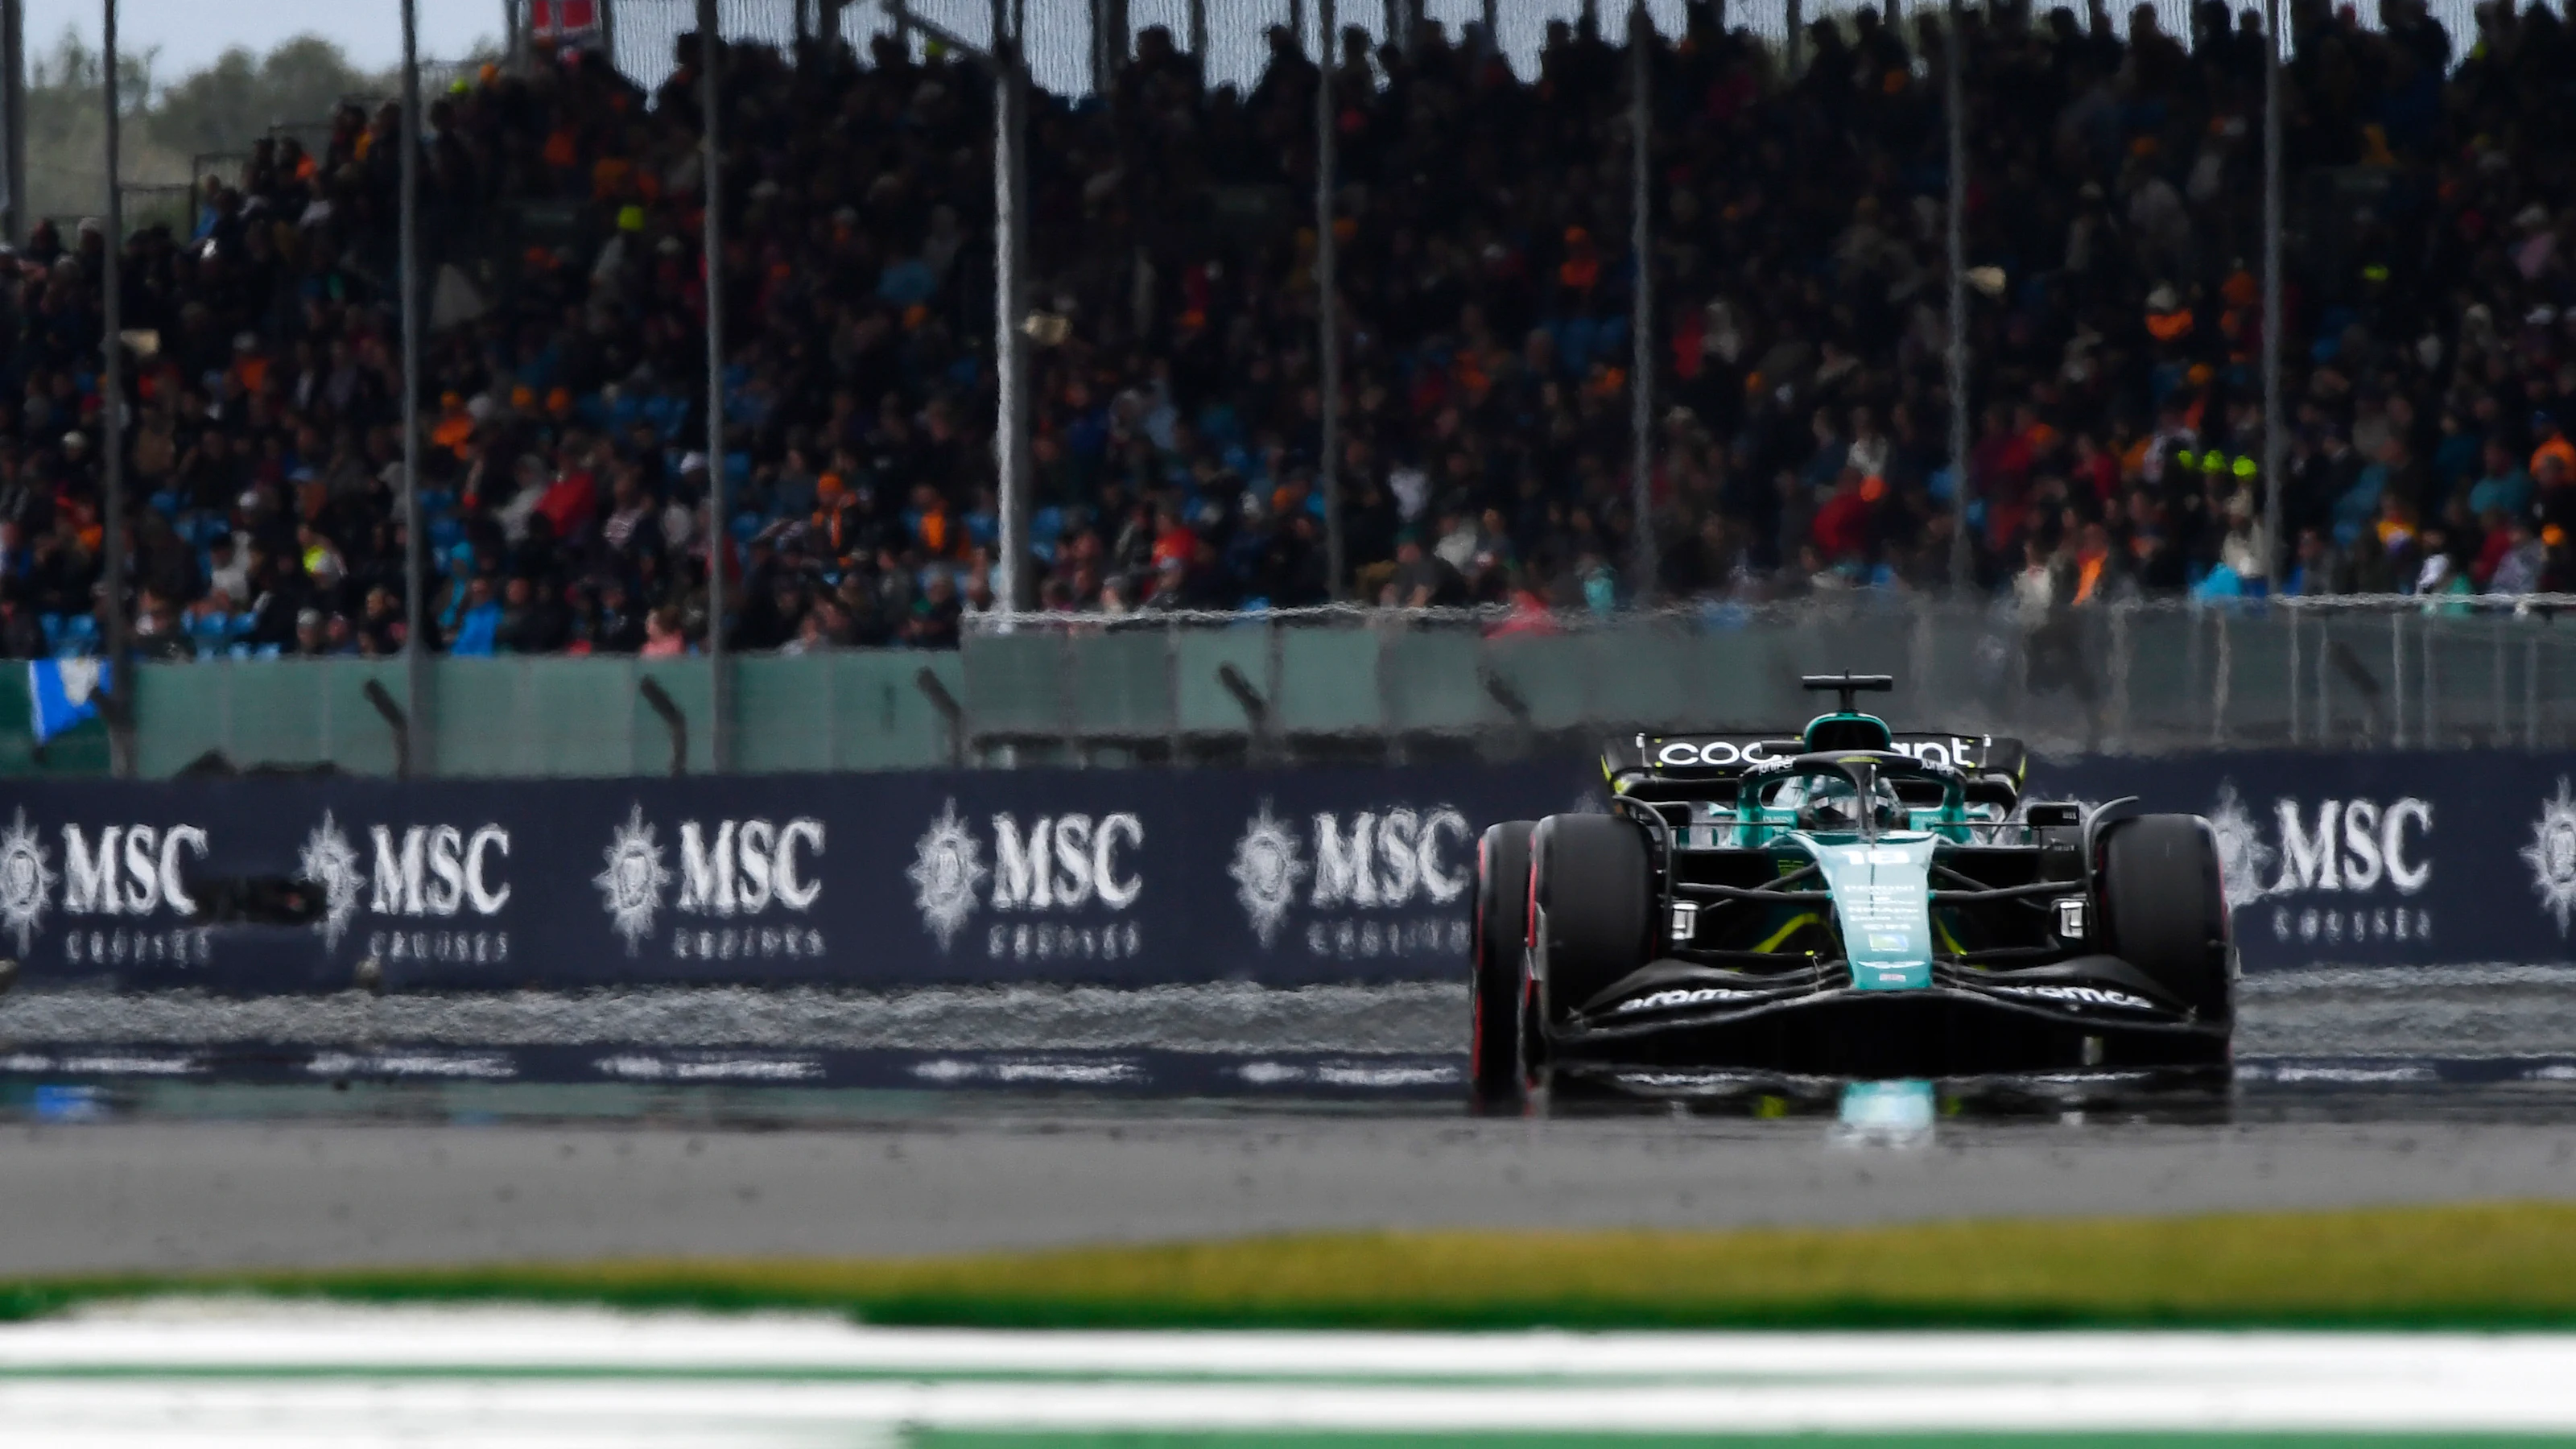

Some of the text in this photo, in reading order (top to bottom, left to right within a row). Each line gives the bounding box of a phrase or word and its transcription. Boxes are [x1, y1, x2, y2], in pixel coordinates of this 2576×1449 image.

[61, 823, 208, 915] MSC
[370, 823, 510, 916] MSC
[676, 816, 826, 914] MSC
[992, 811, 1144, 910] MSC
[1311, 808, 1472, 908] MSC
[2269, 797, 2432, 892] MSC
